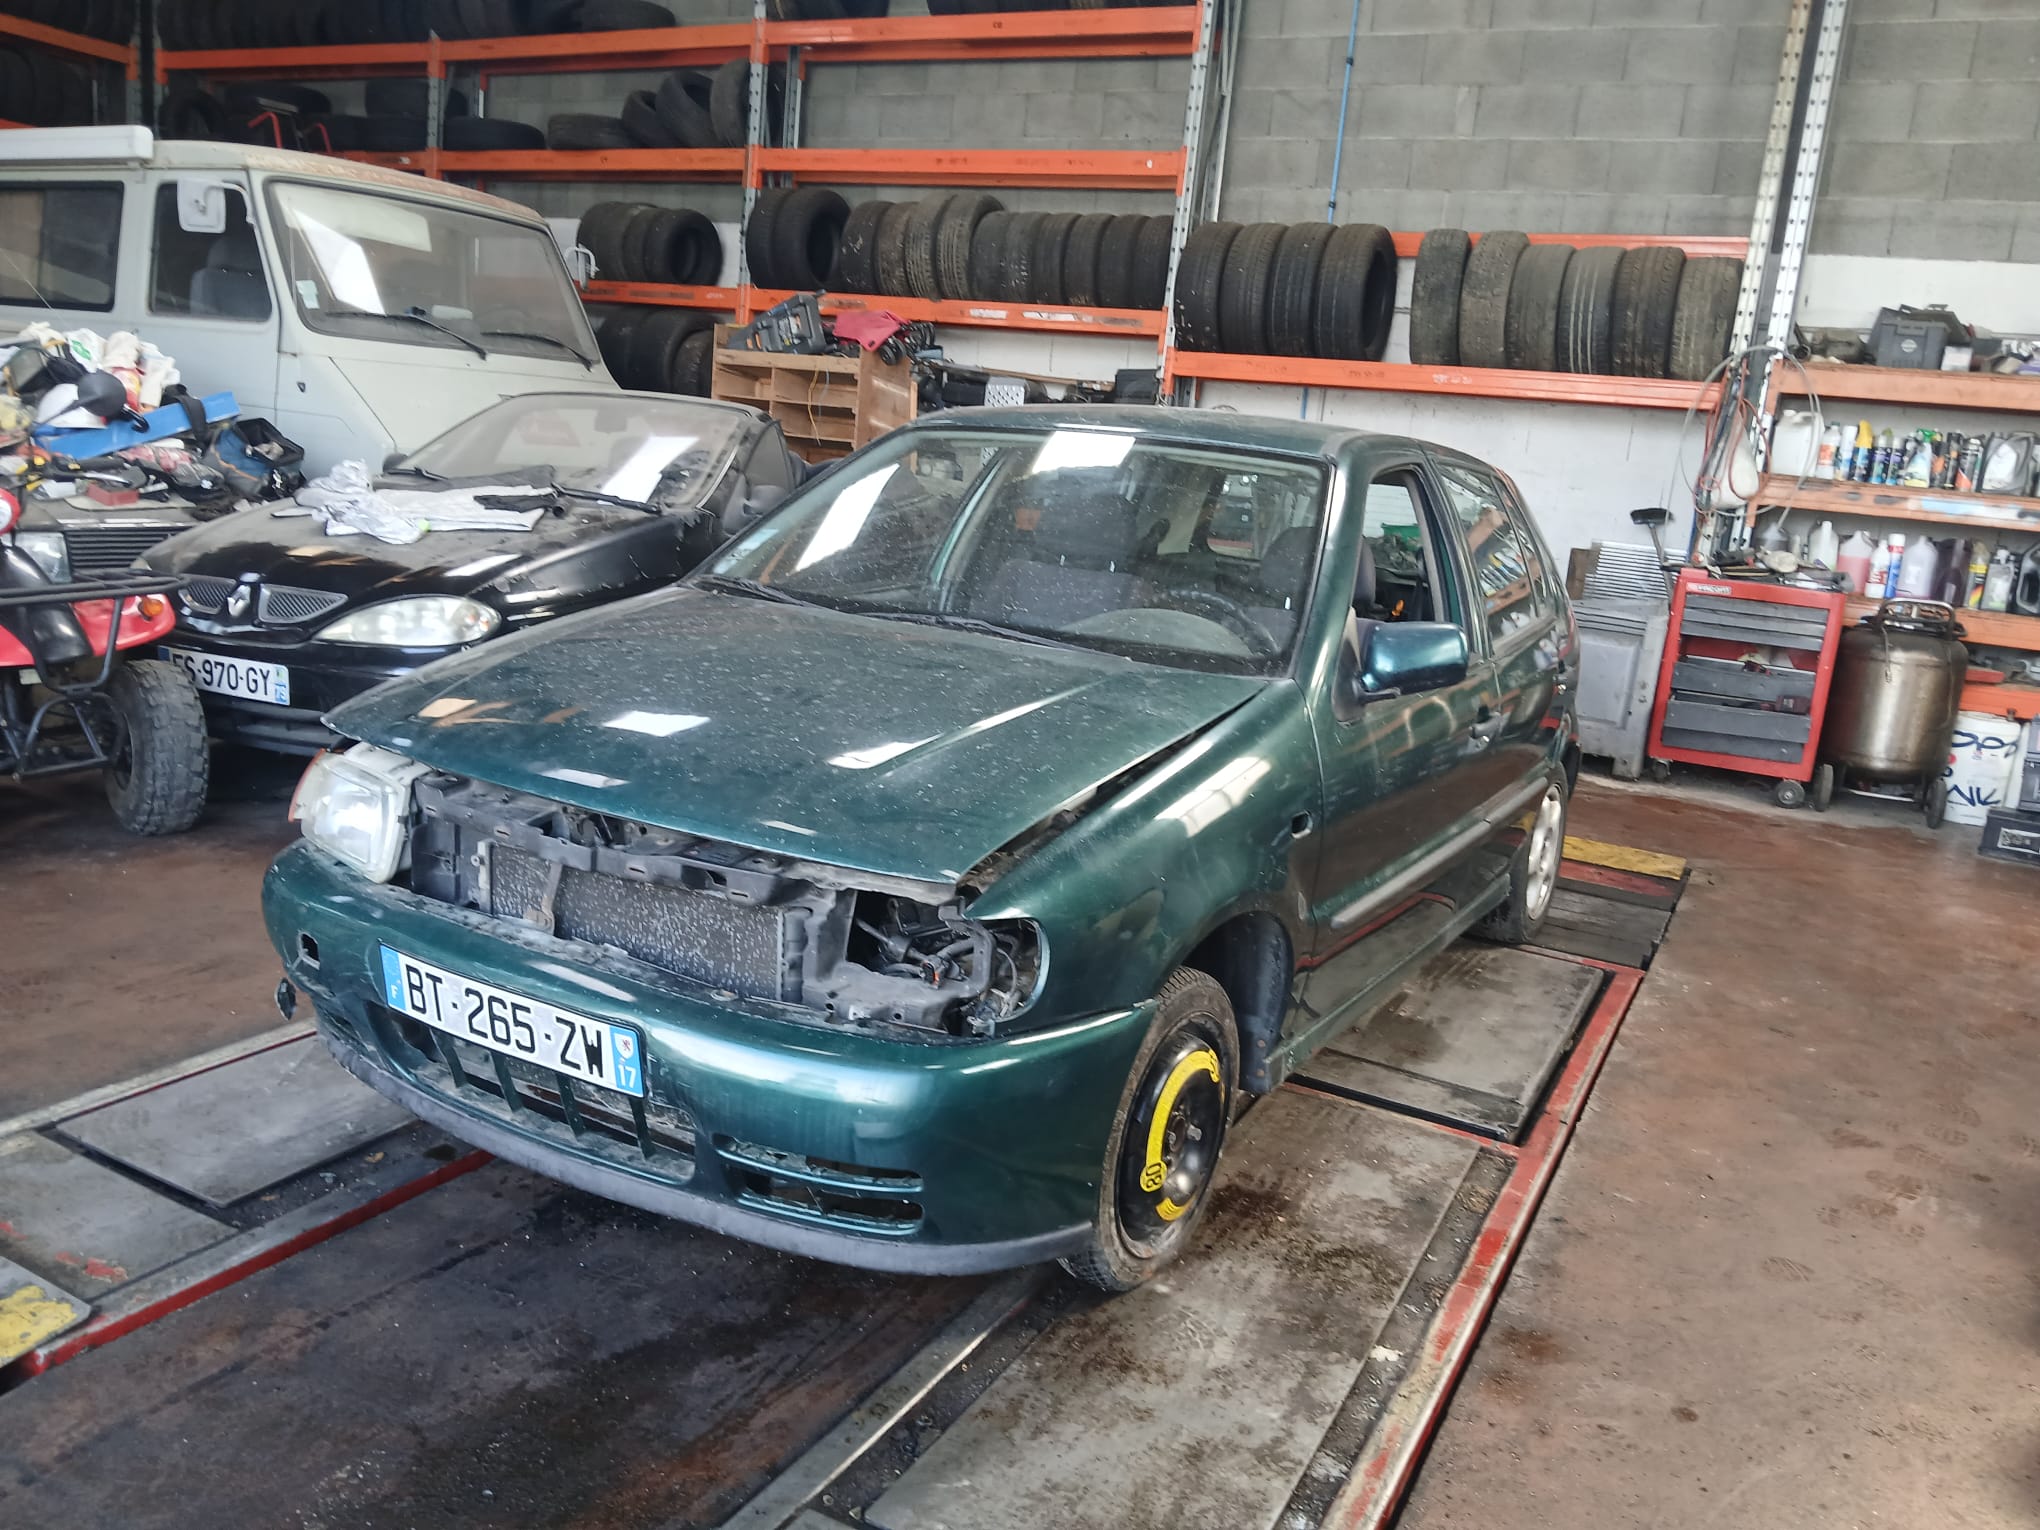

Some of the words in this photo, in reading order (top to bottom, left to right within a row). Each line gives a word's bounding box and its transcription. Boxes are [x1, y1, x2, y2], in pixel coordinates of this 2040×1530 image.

[391, 984, 399, 998] F
[405, 964, 604, 1078] BT-265-ZW
[618, 1064, 637, 1088] 17
